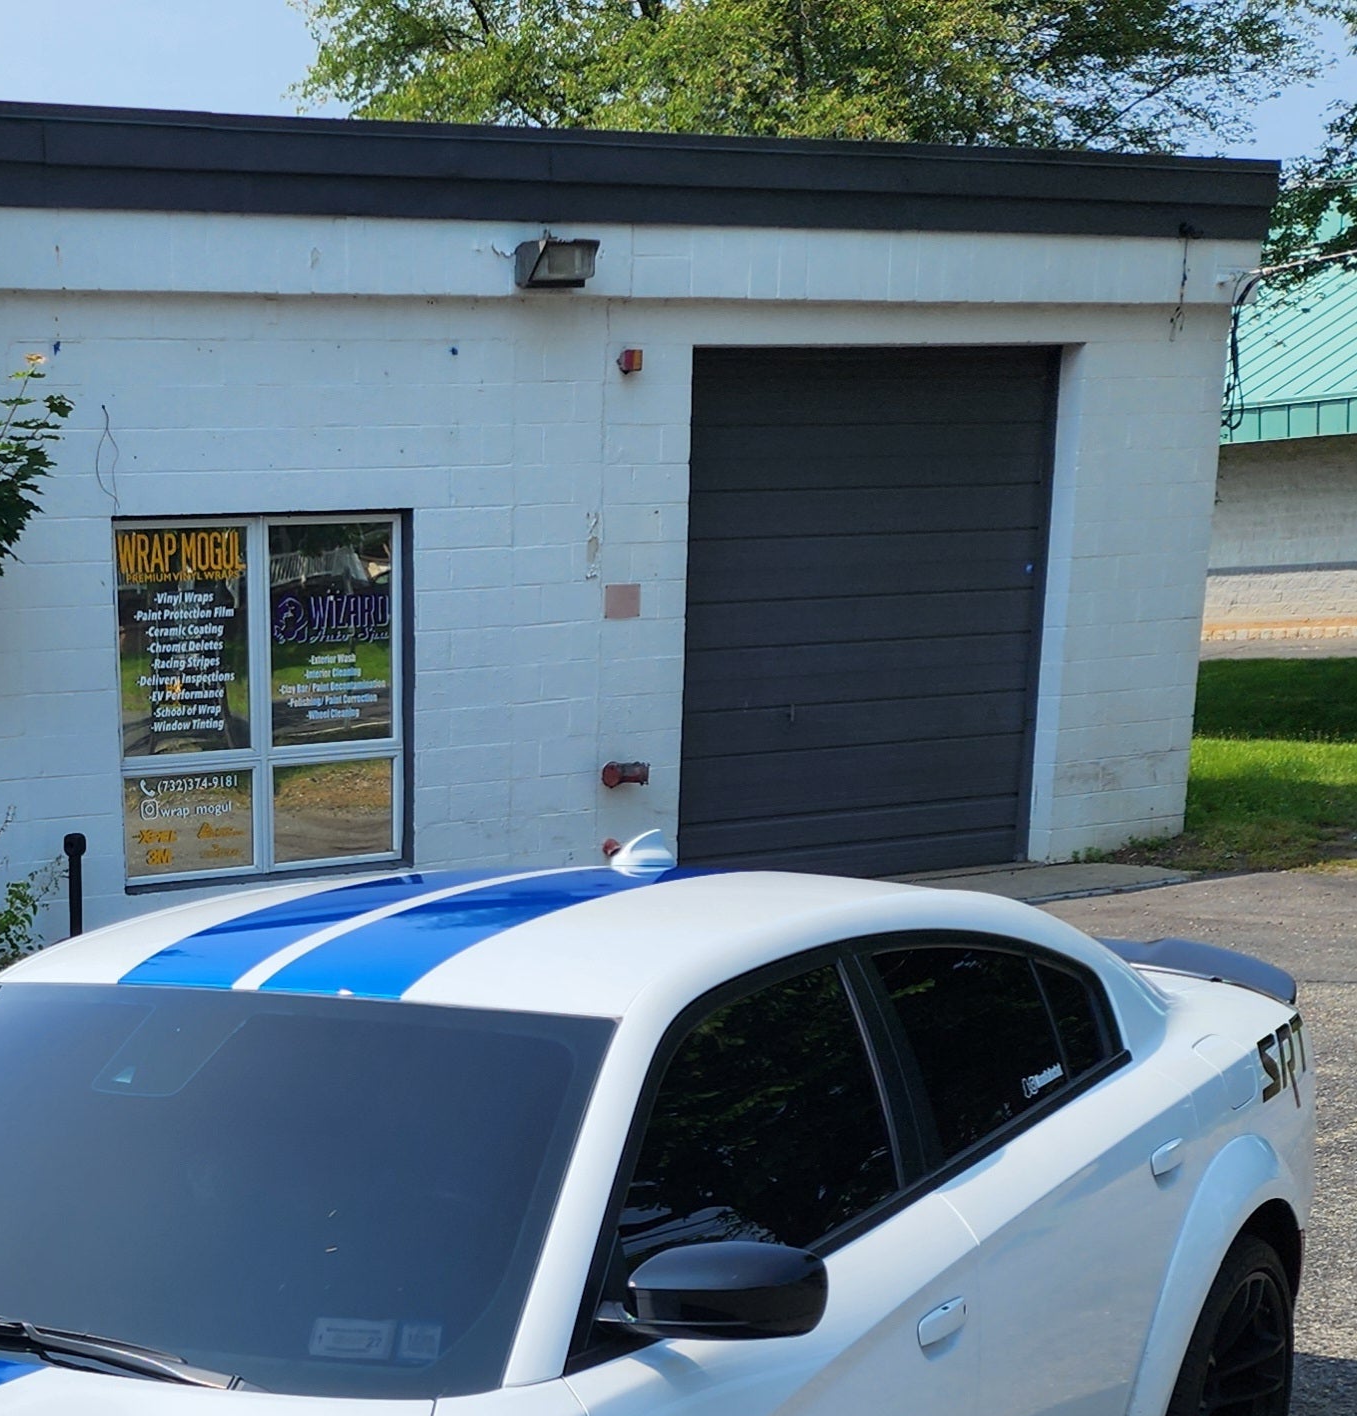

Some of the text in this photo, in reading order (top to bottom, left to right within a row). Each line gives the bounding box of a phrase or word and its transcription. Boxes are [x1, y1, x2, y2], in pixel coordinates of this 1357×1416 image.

[117, 531, 246, 575] WRAP MOGUL
[126, 568, 240, 584] PREMIUM VINYL WRAPS
[184, 592, 214, 605] Wraps
[164, 607, 212, 620] Protection
[214, 606, 235, 618] Film
[310, 594, 390, 630] WIZARD
[187, 622, 224, 638] Coating
[189, 640, 224, 651] Deletes
[187, 656, 220, 670] Stripes
[182, 671, 236, 686] Inspections
[165, 689, 224, 701] Performance
[187, 704, 197, 716] of
[198, 704, 222, 717] Wrap
[192, 718, 224, 731] Tinting
[157, 775, 238, 795] (732)374-9181
[1257, 1012, 1306, 1109] SRT
